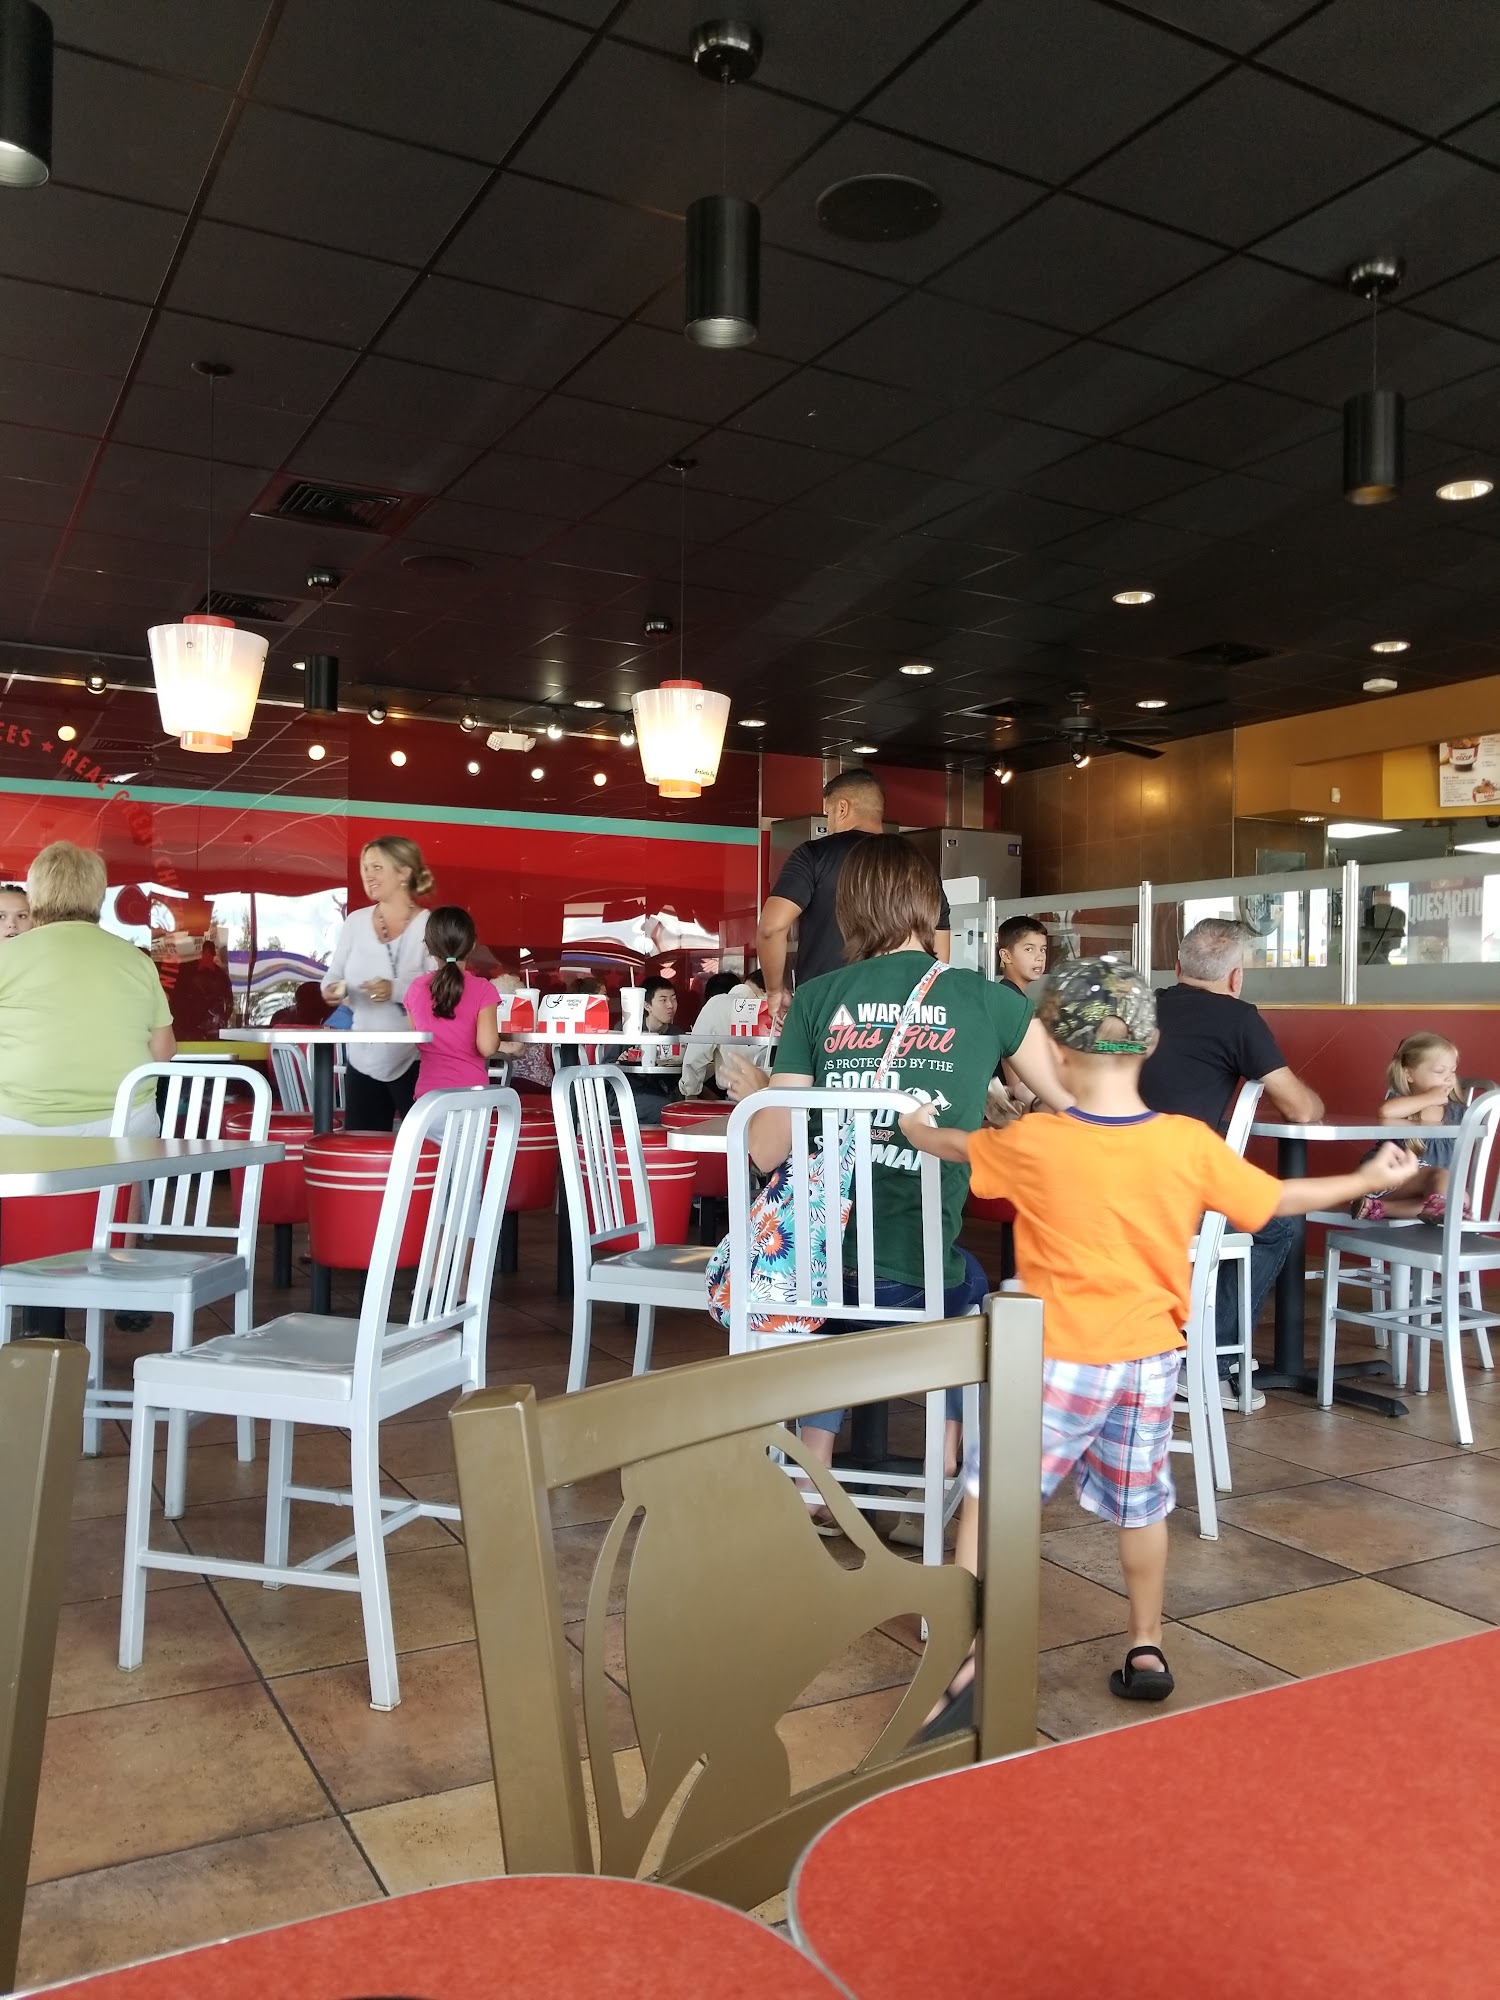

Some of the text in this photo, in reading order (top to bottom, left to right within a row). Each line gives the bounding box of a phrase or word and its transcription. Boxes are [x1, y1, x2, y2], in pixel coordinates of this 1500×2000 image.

[61, 748, 111, 791] REAL
[857, 1003, 947, 1026] WARING
[824, 1023, 956, 1058] This Girl
[909, 1058, 926, 1069] BY
[928, 1059, 954, 1073] THE
